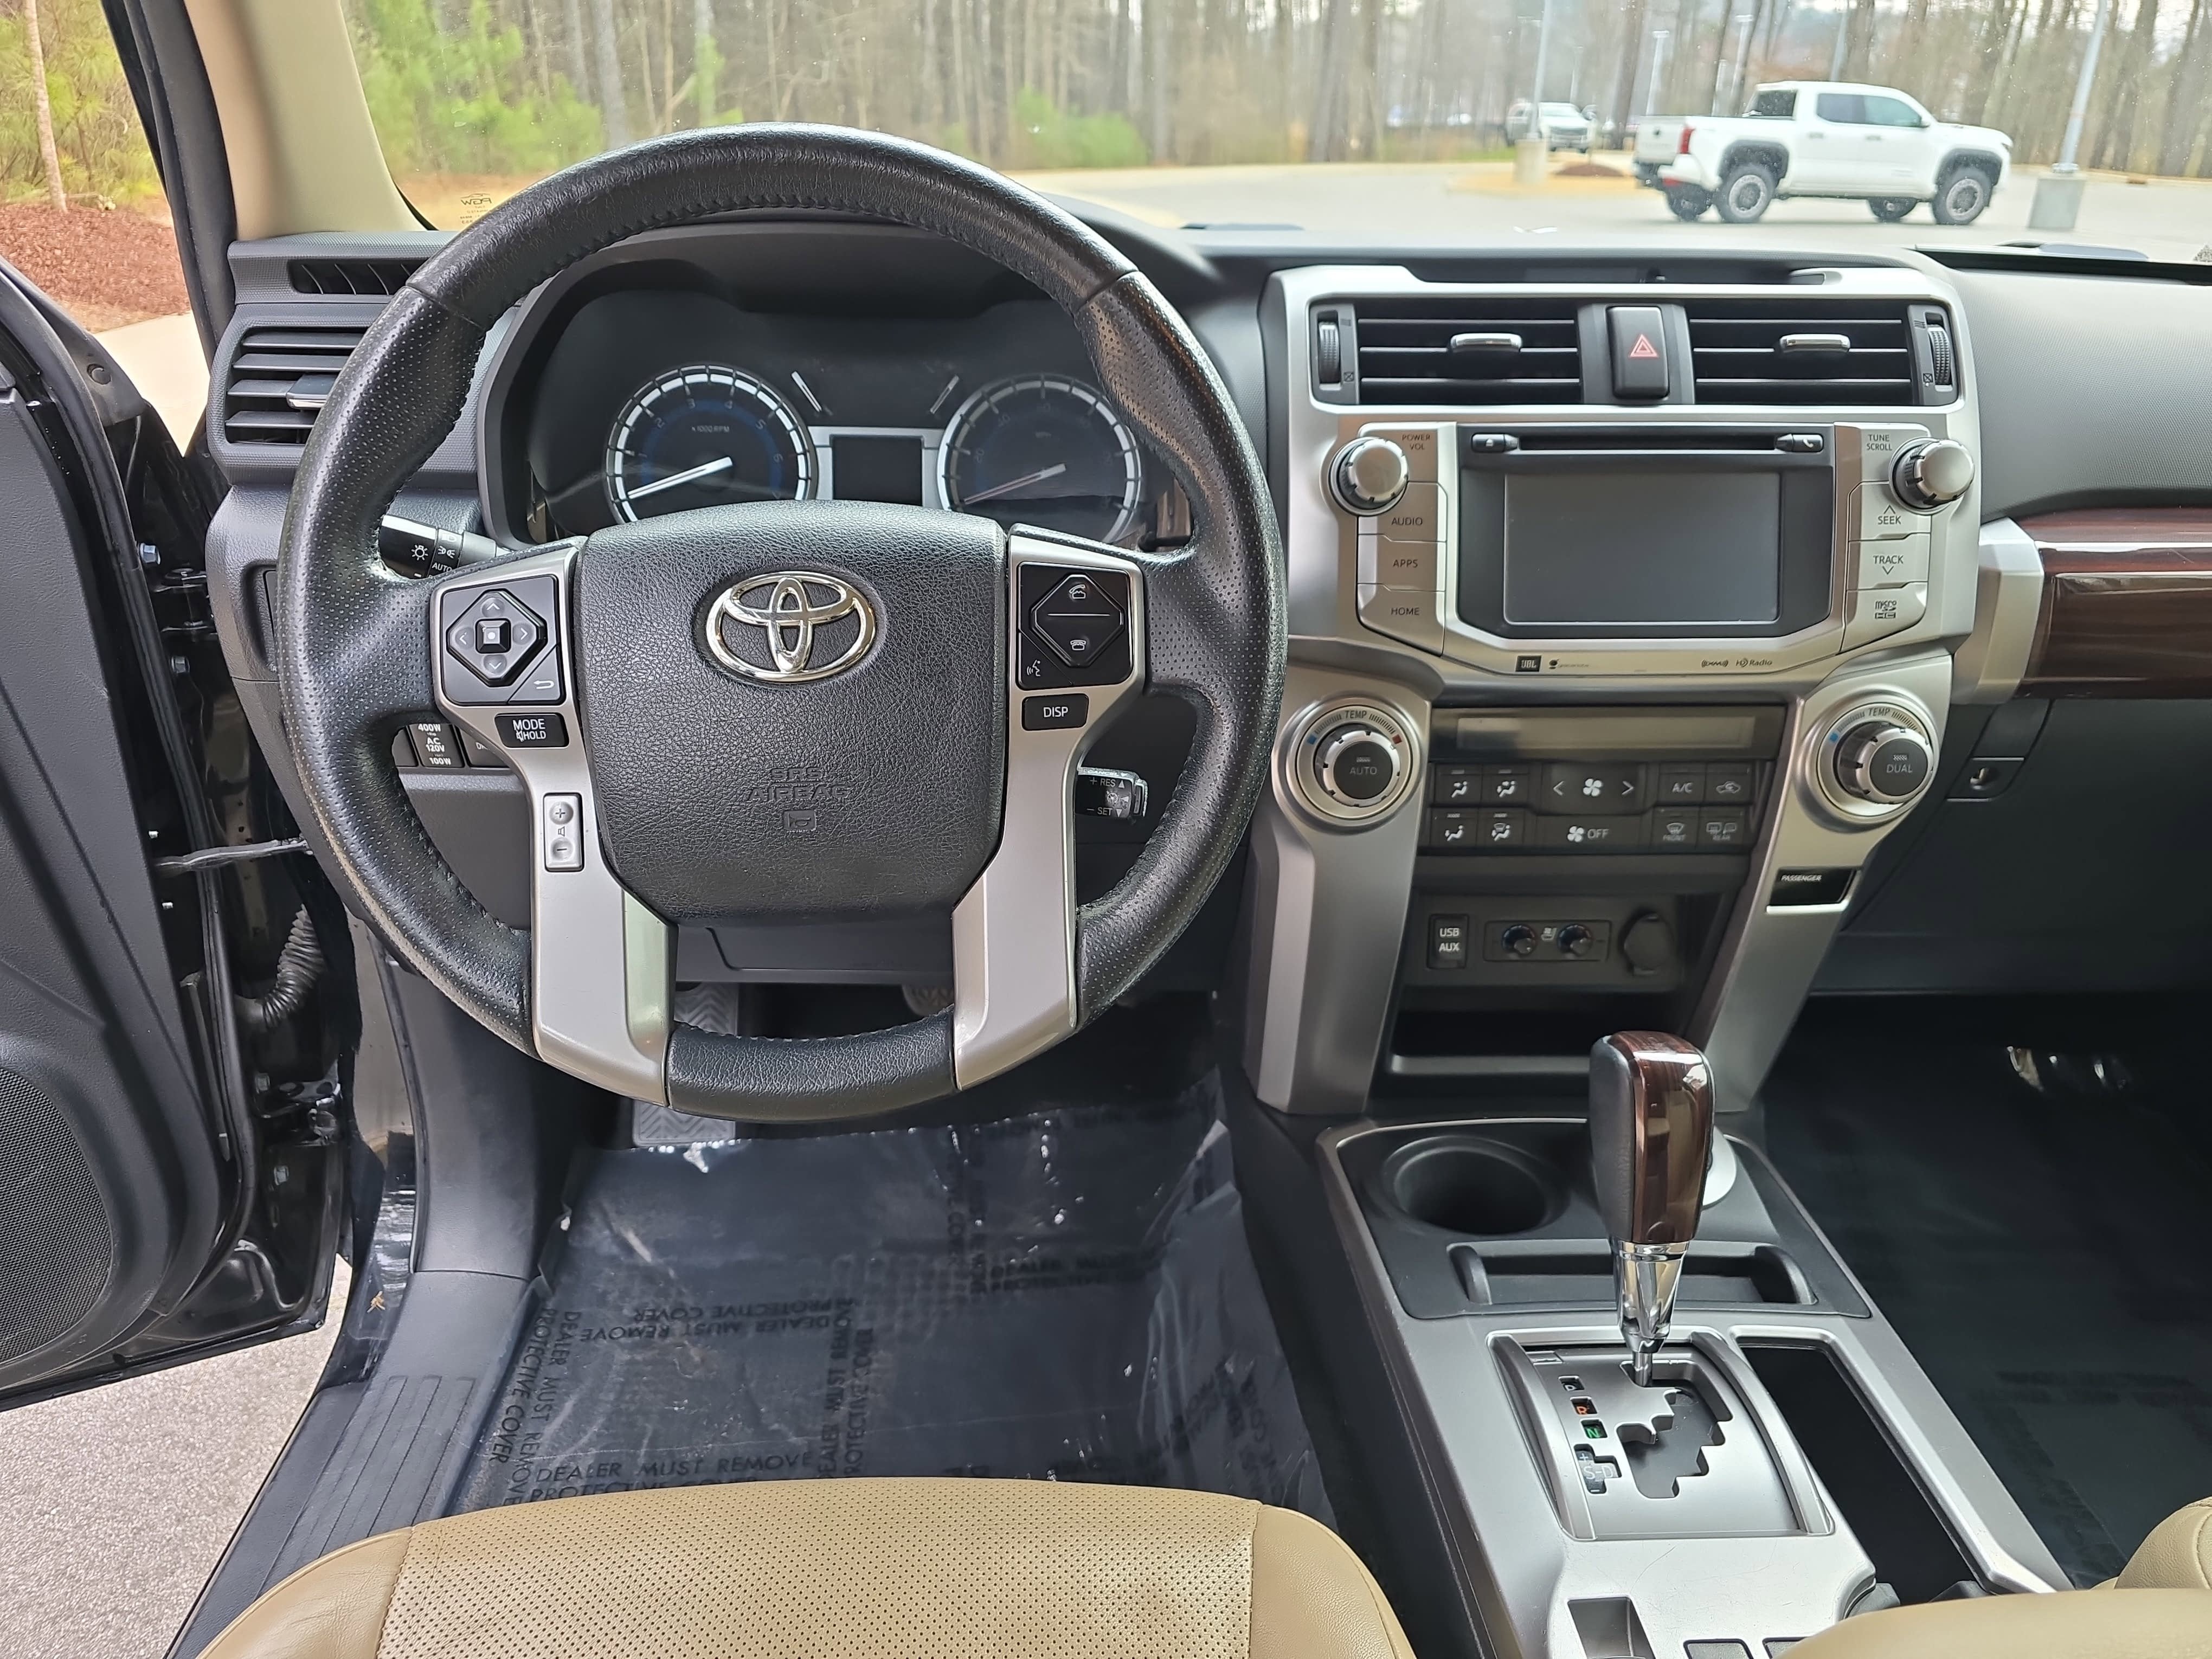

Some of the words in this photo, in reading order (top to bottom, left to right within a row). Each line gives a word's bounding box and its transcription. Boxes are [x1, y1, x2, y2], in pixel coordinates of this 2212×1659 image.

[1391, 517, 1423, 526] AUDIO
[1877, 516, 1902, 525] SEEK
[1392, 559, 1419, 568] APPS
[1873, 555, 1904, 564] TRACK
[432, 562, 453, 573] AUTO
[1390, 607, 1420, 616] HOME
[1520, 659, 1538, 668] JBL
[1043, 706, 1069, 718] DISP
[1345, 710, 1367, 719] TEMP
[1867, 708, 1891, 717] TEMP
[417, 724, 441, 732] 400W
[512, 718, 546, 731] MODE
[523, 731, 547, 740] HOLD
[426, 744, 445, 753] 120V
[770, 767, 824, 780] SRS
[1349, 766, 1378, 775] AUTO
[1886, 763, 1913, 774] DUAL
[1100, 778, 1116, 787] RES
[1671, 782, 1693, 794] A/C
[748, 786, 850, 800] AIRBAG
[1097, 807, 1113, 816] SET
[1587, 828, 1609, 840] OFF
[1439, 928, 1461, 937] USB
[1438, 942, 1459, 953] AUX
[634, 1306, 703, 1322] COVER
[550, 1311, 582, 1366] DEALER
[531, 1377, 560, 1421] MUST
[1577, 1406, 1588, 1414] R
[490, 1405, 525, 1463] COVER
[843, 1384, 867, 1475] ROTECTIVE
[1586, 1427, 1600, 1438] N
[503, 1432, 541, 1506] REMOVE
[535, 1462, 622, 1482] DEALER
[635, 1459, 703, 1476] MUST
[716, 1452, 812, 1473] REMOVE
